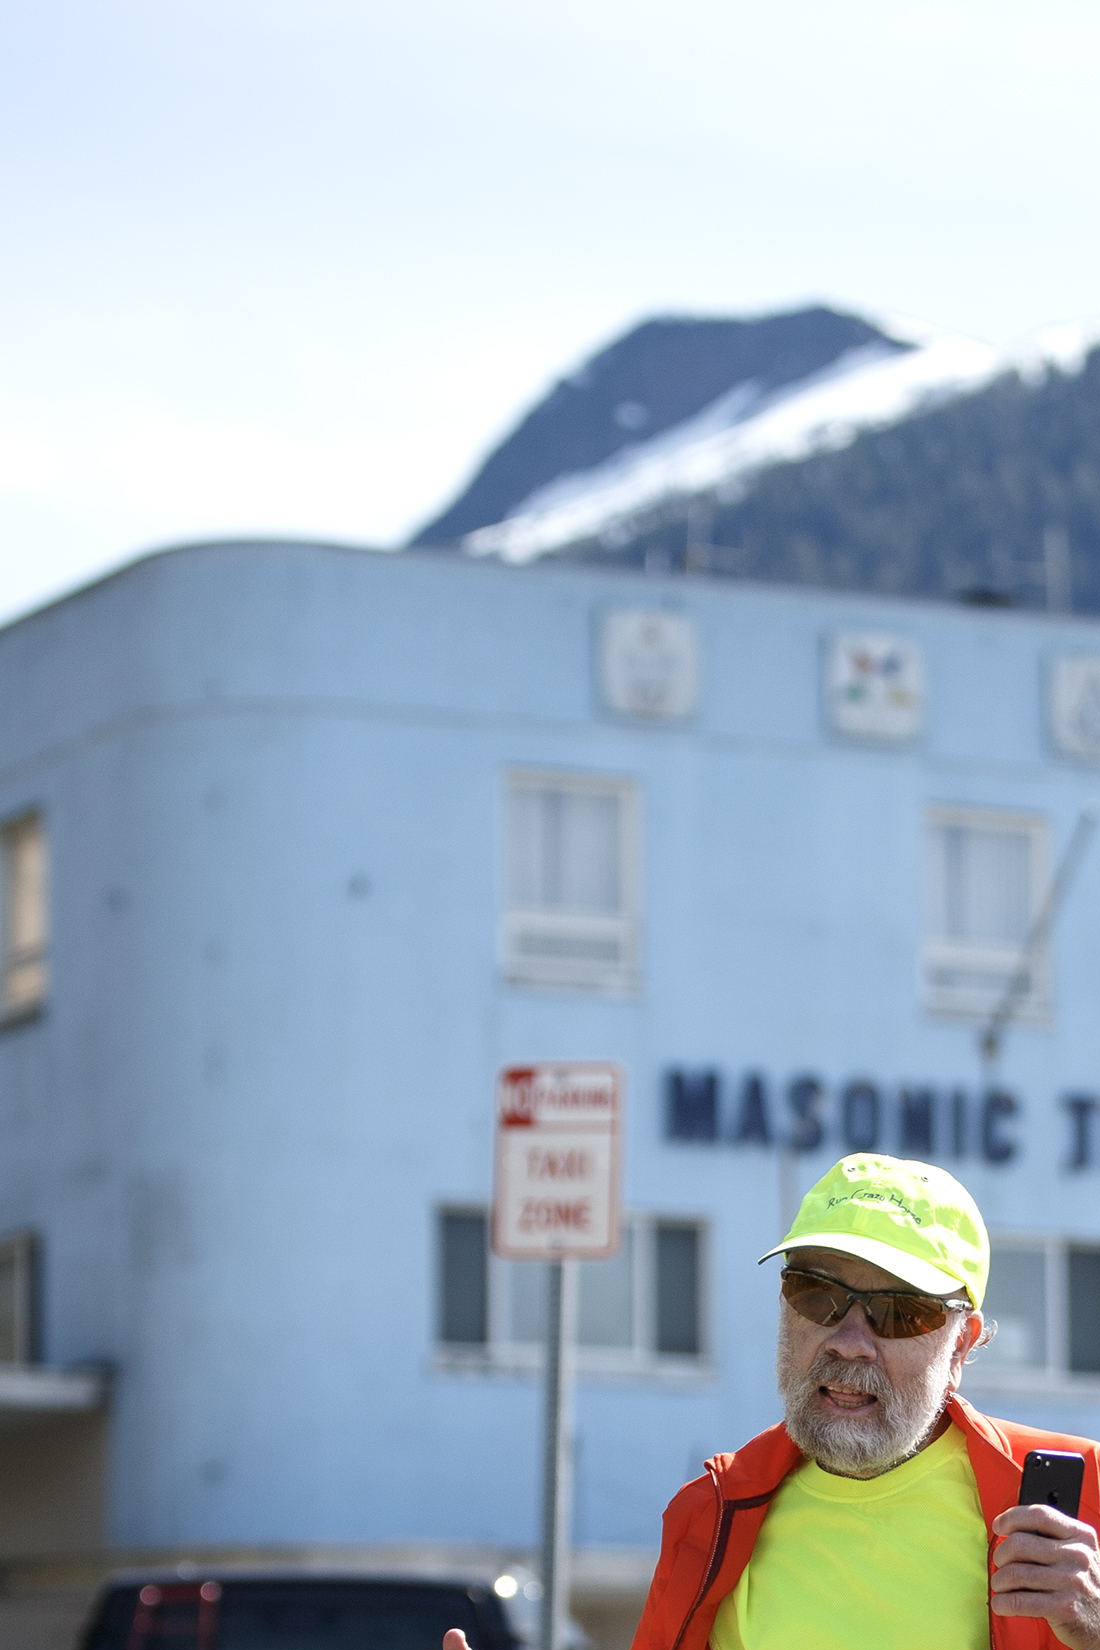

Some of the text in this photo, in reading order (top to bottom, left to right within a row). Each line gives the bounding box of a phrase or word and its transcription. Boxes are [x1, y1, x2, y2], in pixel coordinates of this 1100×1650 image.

[664, 1068, 1018, 1165] MASONIC
[518, 1197, 591, 1234] ZONE
[826, 1188, 922, 1224] Run Crazy Horse
